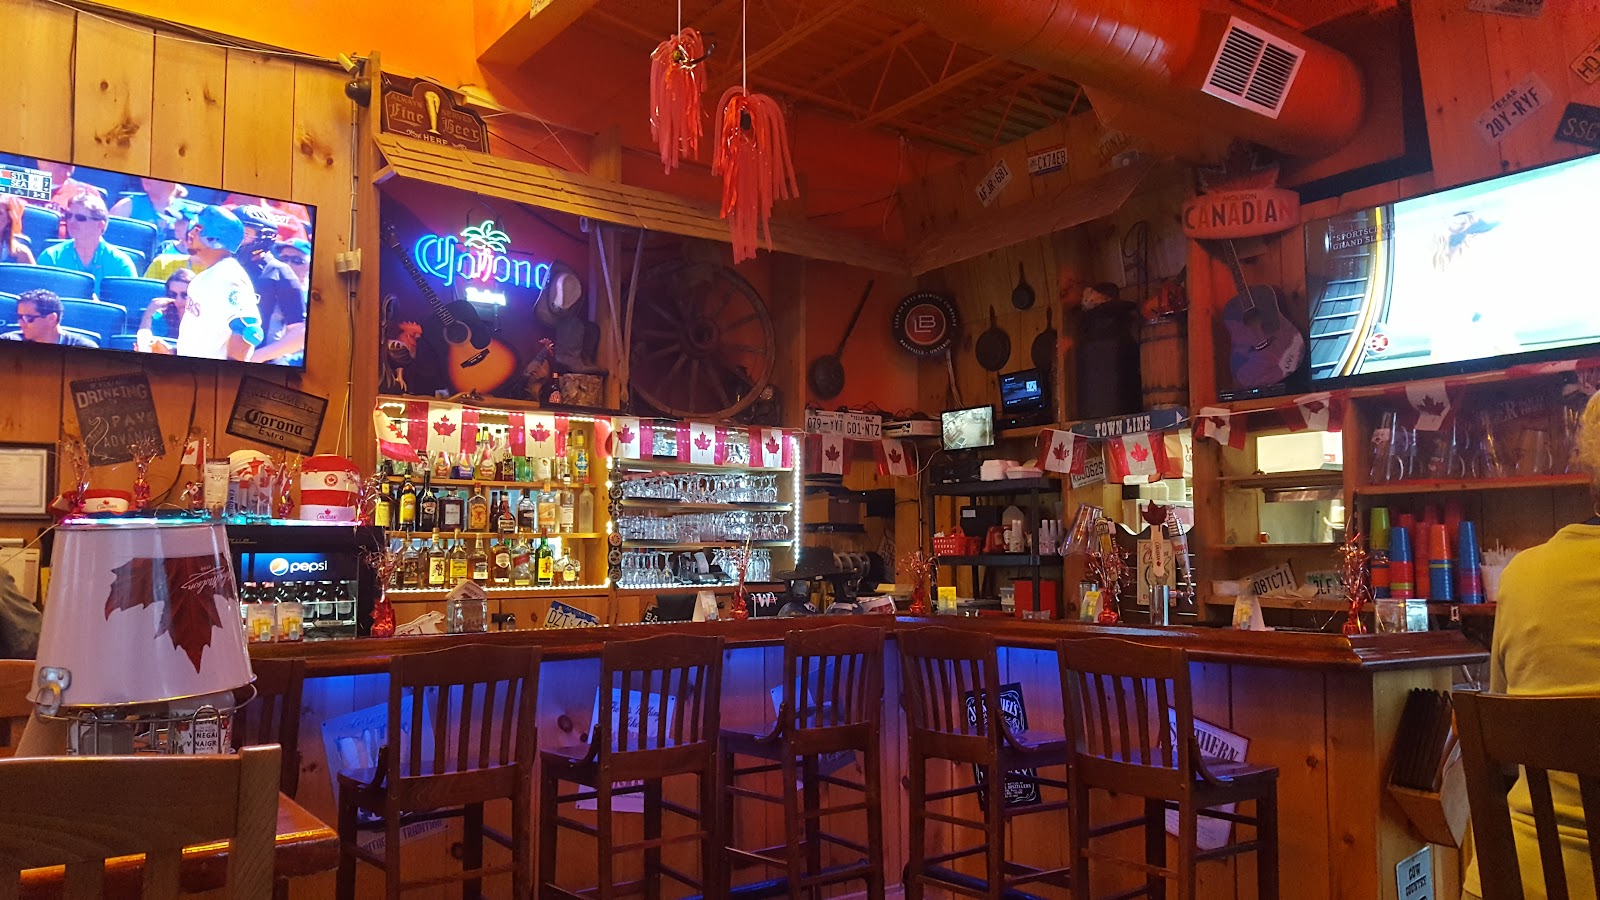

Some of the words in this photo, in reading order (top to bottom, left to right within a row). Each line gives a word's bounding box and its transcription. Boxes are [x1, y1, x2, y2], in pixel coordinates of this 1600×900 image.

[1490, 88, 1518, 111] TEXAS
[389, 103, 424, 123] Fine
[442, 117, 479, 139] Beer
[1184, 199, 1297, 230] CANADIAN
[1333, 239, 1362, 250] GRAND
[414, 234, 549, 289] Corona
[75, 384, 148, 409] DRINKING
[244, 408, 305, 436] Corona
[1095, 419, 1122, 437] TOWN
[1126, 414, 1151, 433] LINE
[258, 427, 285, 441] Extra
[289, 560, 328, 574] pepsi
[189, 731, 218, 739] VNEGA
[1169, 721, 1239, 761] STHERN
[1408, 862, 1421, 881] COW
